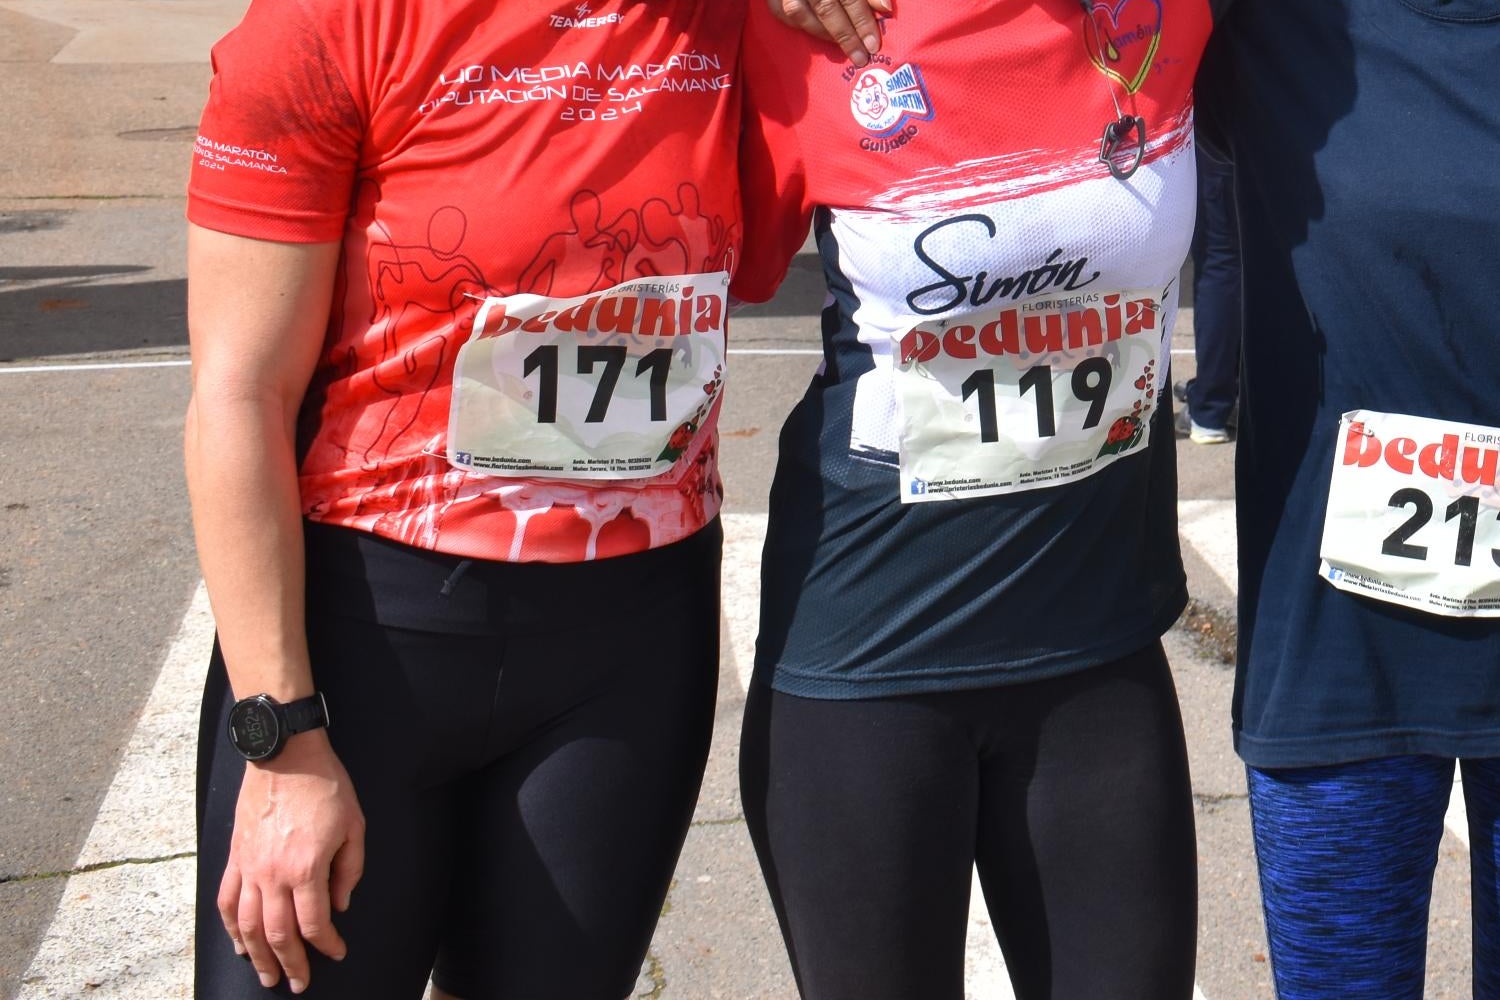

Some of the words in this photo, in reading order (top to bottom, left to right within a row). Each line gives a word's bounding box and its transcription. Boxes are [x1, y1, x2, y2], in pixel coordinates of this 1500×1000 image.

[550, 13, 624, 28] TEAMERGY
[491, 62, 591, 82] MEDIA
[597, 49, 720, 81] MARATÓN
[572, 86, 601, 101] DE
[890, 93, 924, 110] MARTIN
[560, 101, 643, 121] 2024
[860, 125, 918, 153] Guijuelo
[214, 142, 277, 162] MARATÓN
[199, 159, 225, 172] 2024
[215, 154, 287, 175] SALAMANCA
[906, 213, 1101, 316] Simón
[477, 286, 721, 340] bedunia
[1021, 292, 1100, 313] FLORISTERÍAS
[900, 294, 1156, 364] bedunia
[523, 345, 673, 423] 171
[961, 357, 1113, 444] 119
